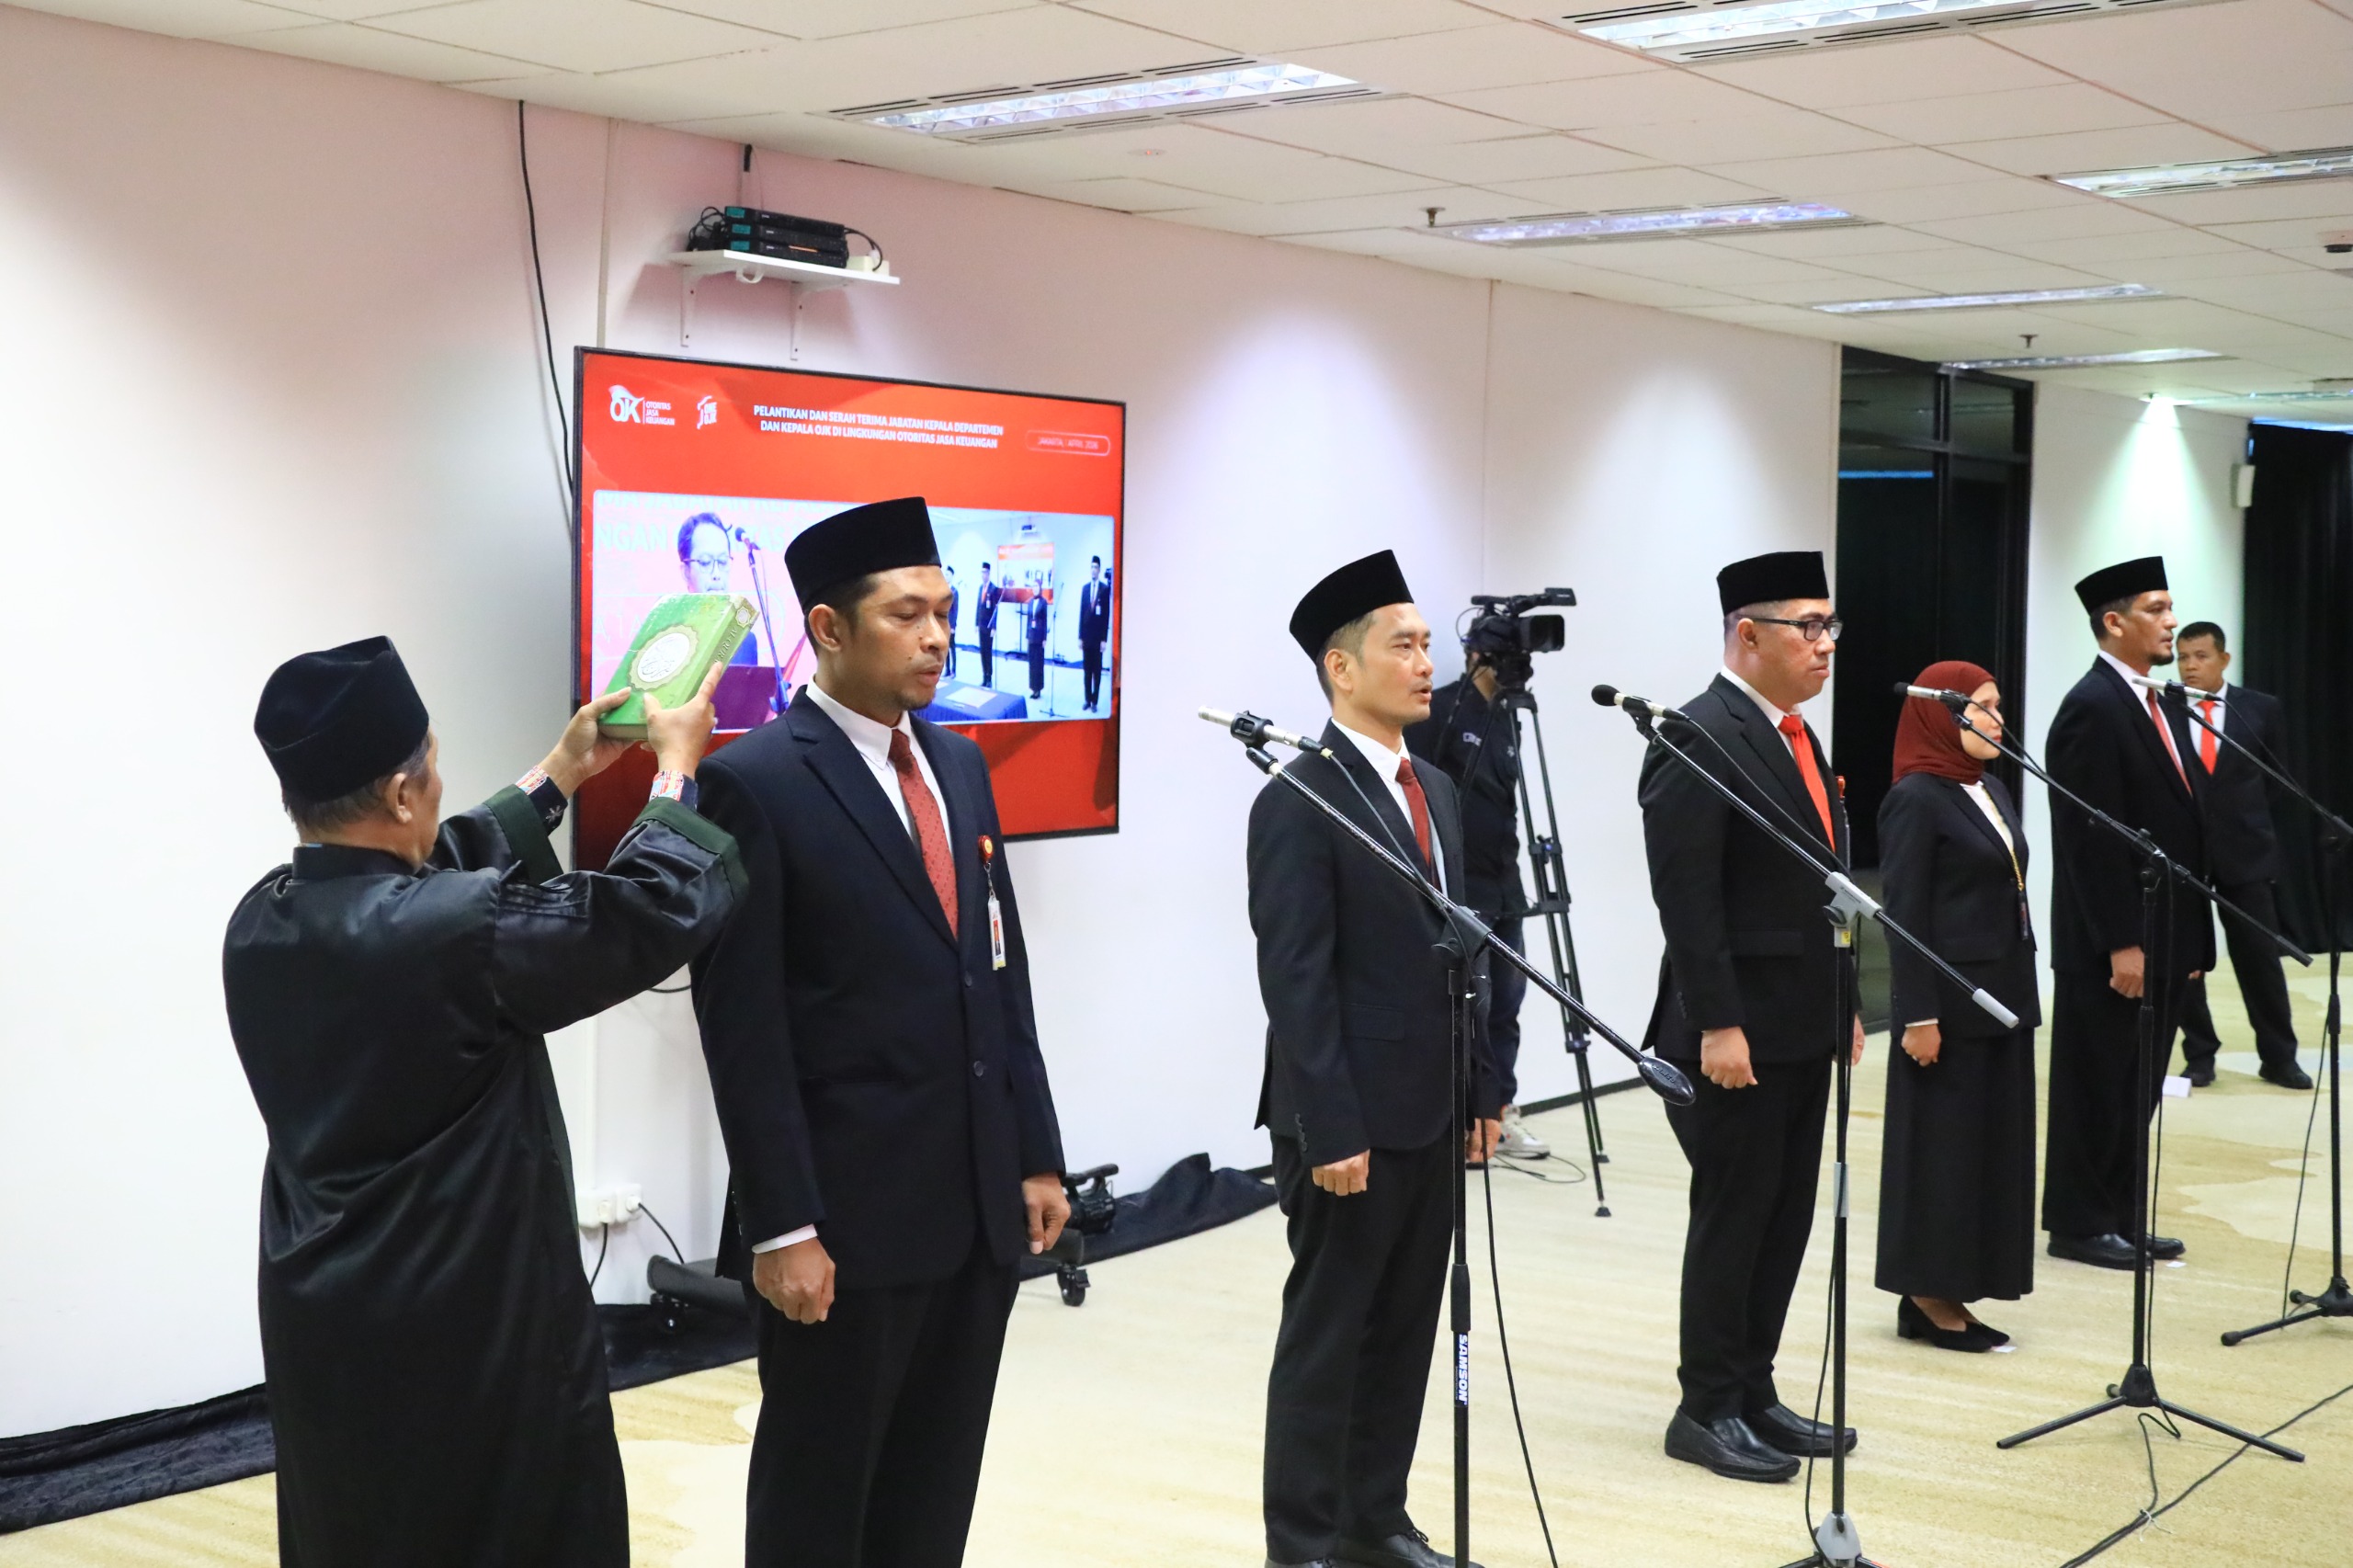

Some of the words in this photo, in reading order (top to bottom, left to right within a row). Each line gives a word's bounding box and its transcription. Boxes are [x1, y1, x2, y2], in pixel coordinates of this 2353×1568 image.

[754, 405, 808, 419] PELANTIKAN
[810, 410, 827, 421] DAN
[829, 411, 855, 424] SERAH
[857, 414, 887, 426] TERIMA
[889, 416, 923, 429] JABATAN
[924, 420, 954, 432] KEPALA
[955, 422, 1004, 436] DEPARTEMEN
[760, 420, 779, 432] DAN
[781, 422, 813, 435] KEPALA
[815, 425, 831, 436] OJK
[833, 426, 841, 437] DI
[843, 427, 895, 441] LINGKUNGAN
[897, 431, 935, 443] OTORITAS
[936, 434, 954, 446] JASA
[955, 436, 997, 449] KEUANGAN
[1459, 1334, 1468, 1403] SAMSON
